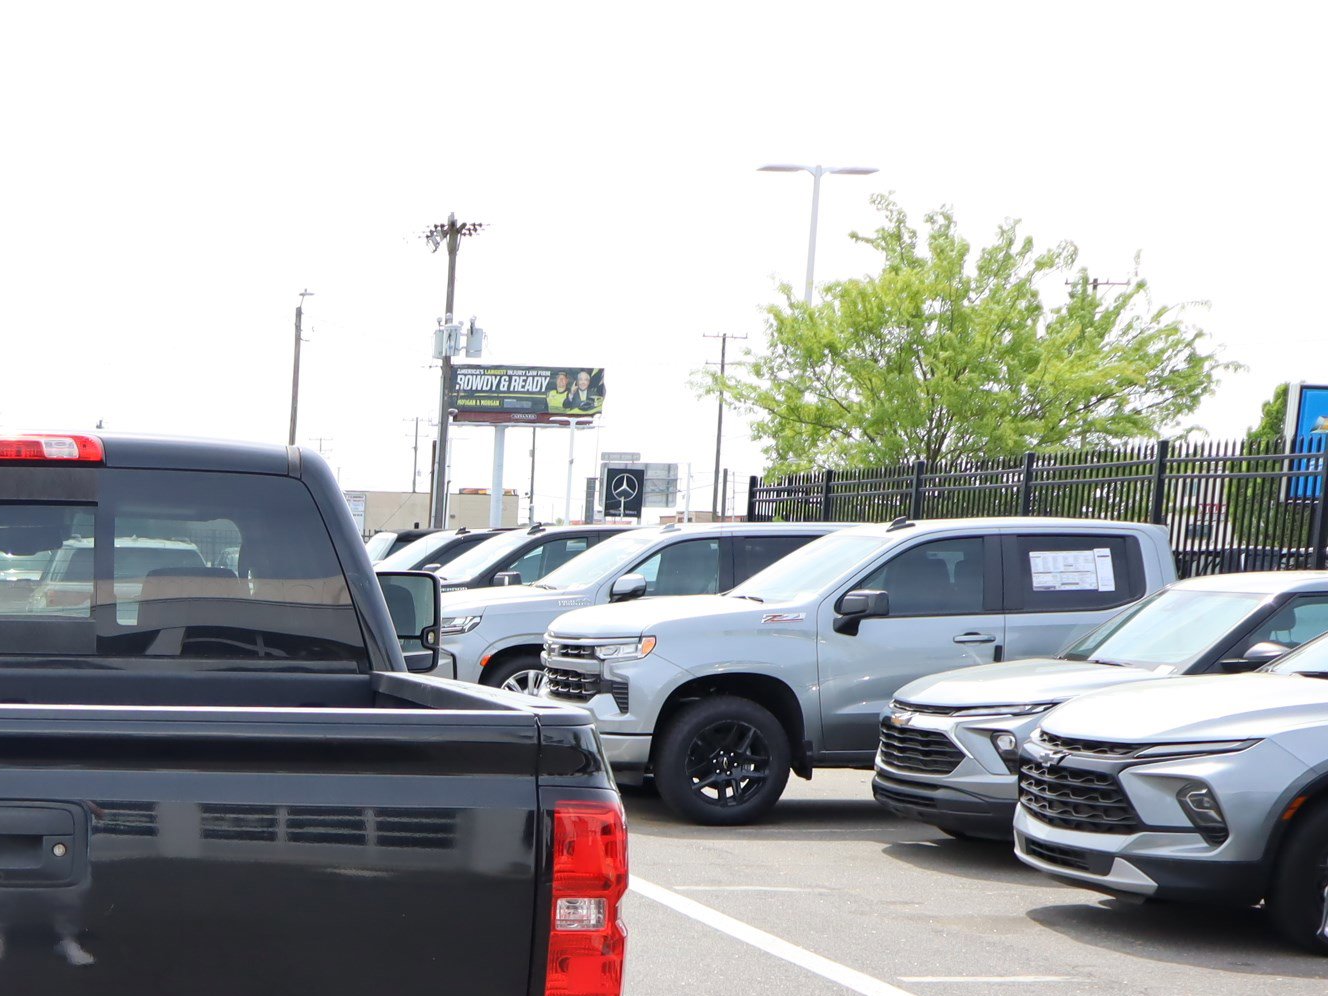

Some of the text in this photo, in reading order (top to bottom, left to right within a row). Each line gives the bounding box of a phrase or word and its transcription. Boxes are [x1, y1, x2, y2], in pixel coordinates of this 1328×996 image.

[456, 375, 550, 392] ROWDY & READY
